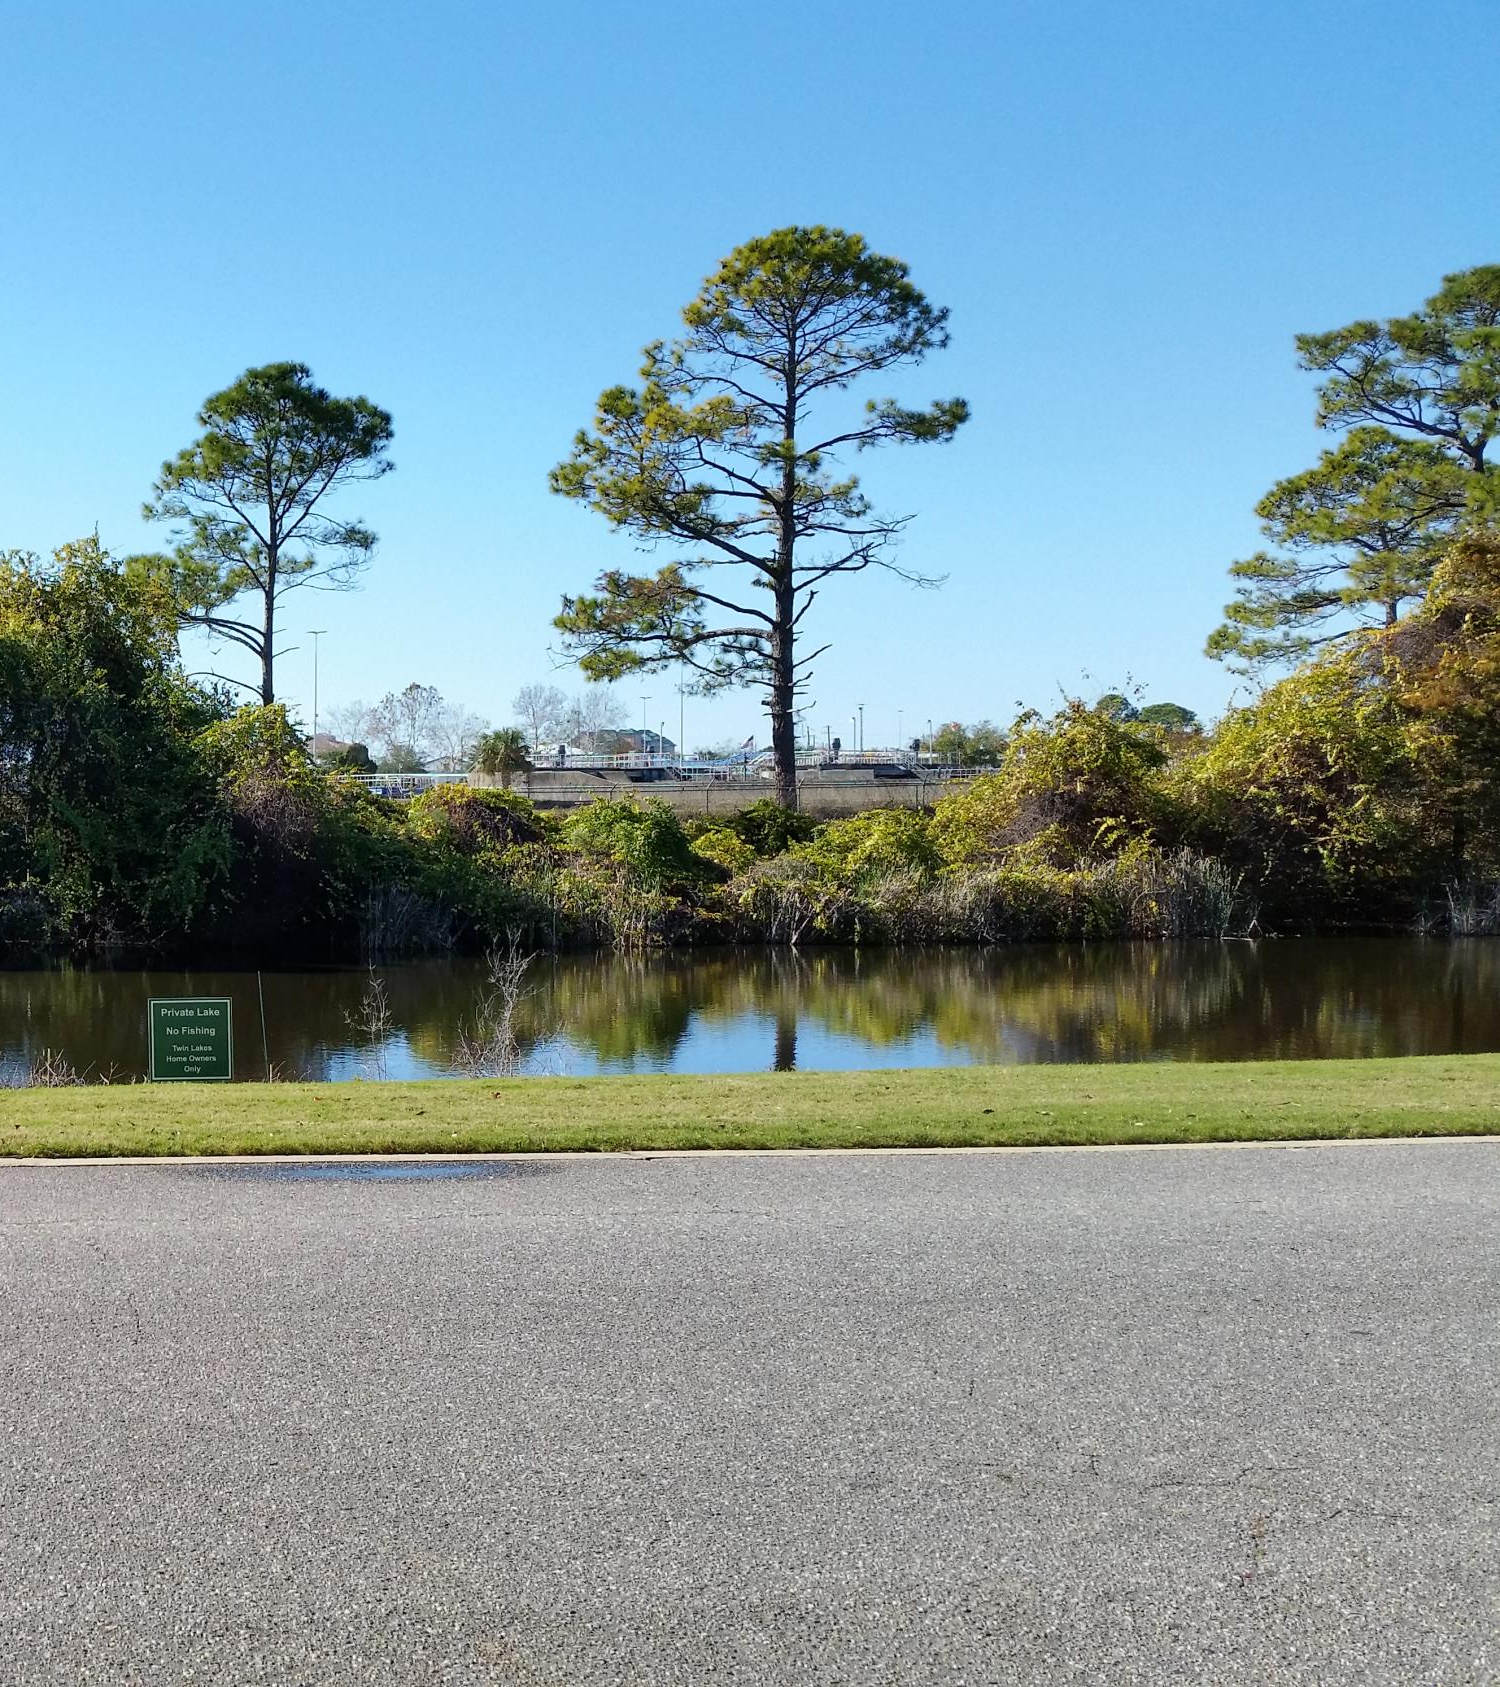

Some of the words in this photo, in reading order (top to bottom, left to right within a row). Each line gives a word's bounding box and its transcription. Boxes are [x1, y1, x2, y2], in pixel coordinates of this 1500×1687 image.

[161, 1008, 194, 1017] Private
[197, 1008, 220, 1016] Lake
[166, 1027, 179, 1035] No
[181, 1026, 216, 1036] Fishing
[183, 1066, 202, 1074] Only
